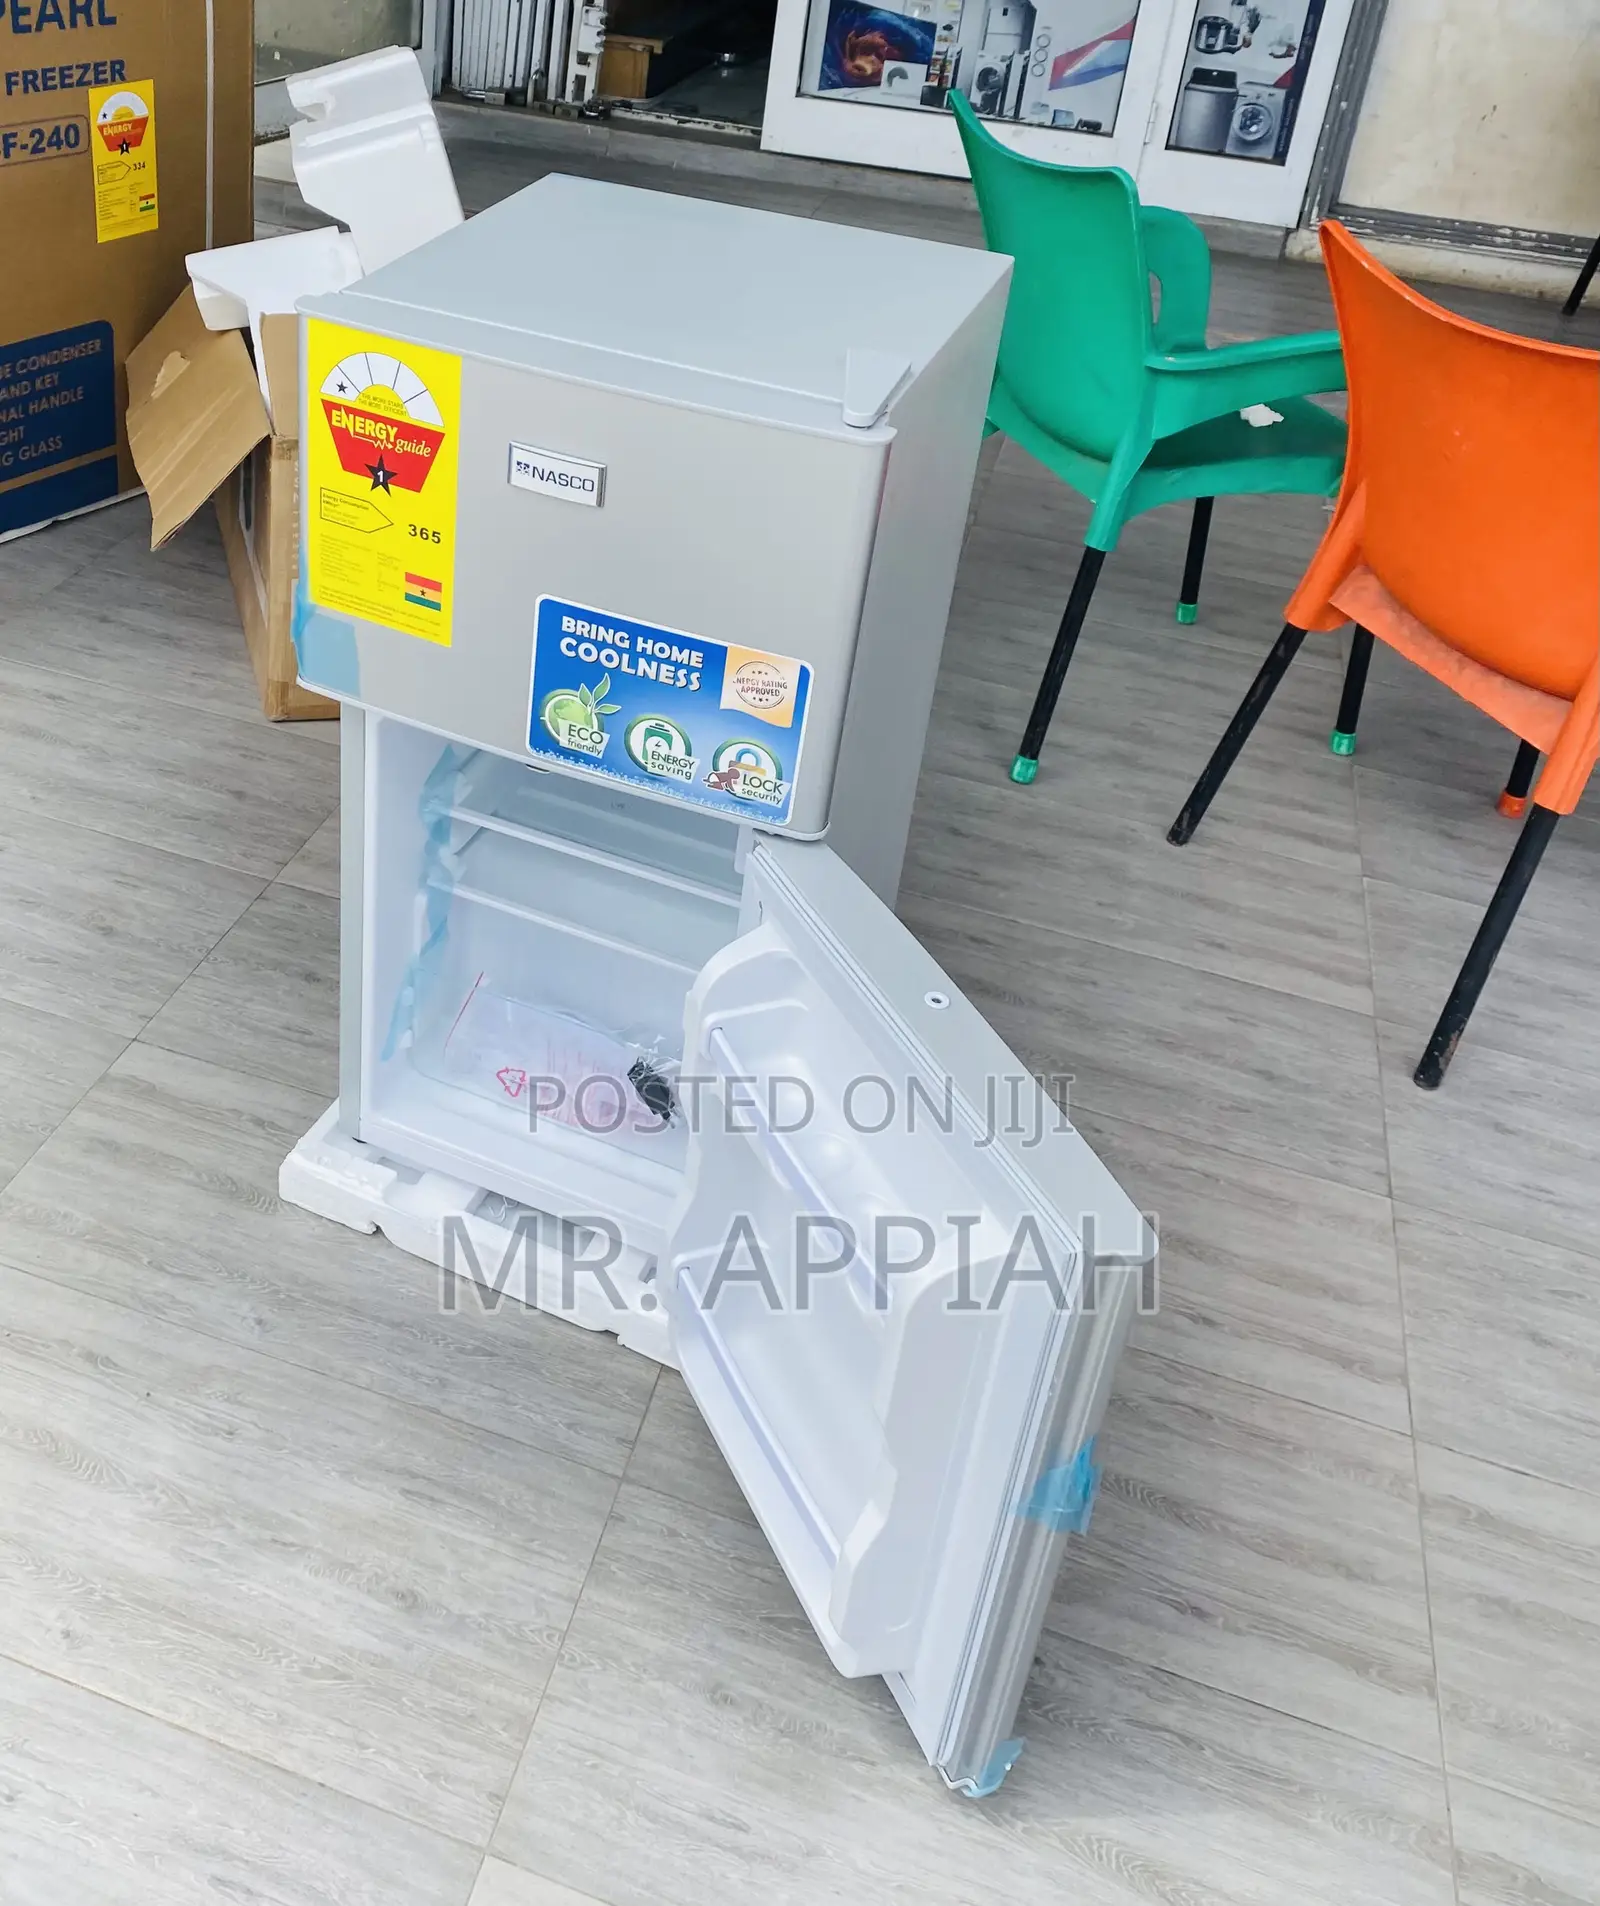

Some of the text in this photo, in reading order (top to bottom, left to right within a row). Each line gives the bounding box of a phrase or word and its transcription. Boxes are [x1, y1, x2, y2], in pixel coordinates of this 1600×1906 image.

[0, 0, 117, 34] EARL
[5, 59, 127, 95] FREEZER
[103, 122, 133, 137] ENERGY
[0, 123, 81, 159] F-240
[122, 143, 127, 151] 1
[132, 161, 146, 171] 334
[0, 339, 102, 380] E CONDENSER
[35, 372, 60, 391] KEY
[29, 386, 84, 415] HANDLE
[331, 406, 399, 442] ENERGY
[18, 436, 63, 460] GLASS
[395, 438, 431, 458] guide
[377, 470, 384, 483] 1
[532, 466, 595, 492] NASCO
[408, 523, 442, 545] 365
[561, 615, 704, 669] BRING HOME
[559, 636, 702, 692] COOLNESS
[740, 685, 780, 697] APPROVED
[761, 680, 788, 690] RATING
[567, 724, 604, 745] ECO
[567, 737, 603, 756] friendly
[651, 750, 696, 770] ENERGY
[650, 762, 692, 780] saving
[742, 773, 784, 795] LOCK
[741, 786, 782, 805] security
